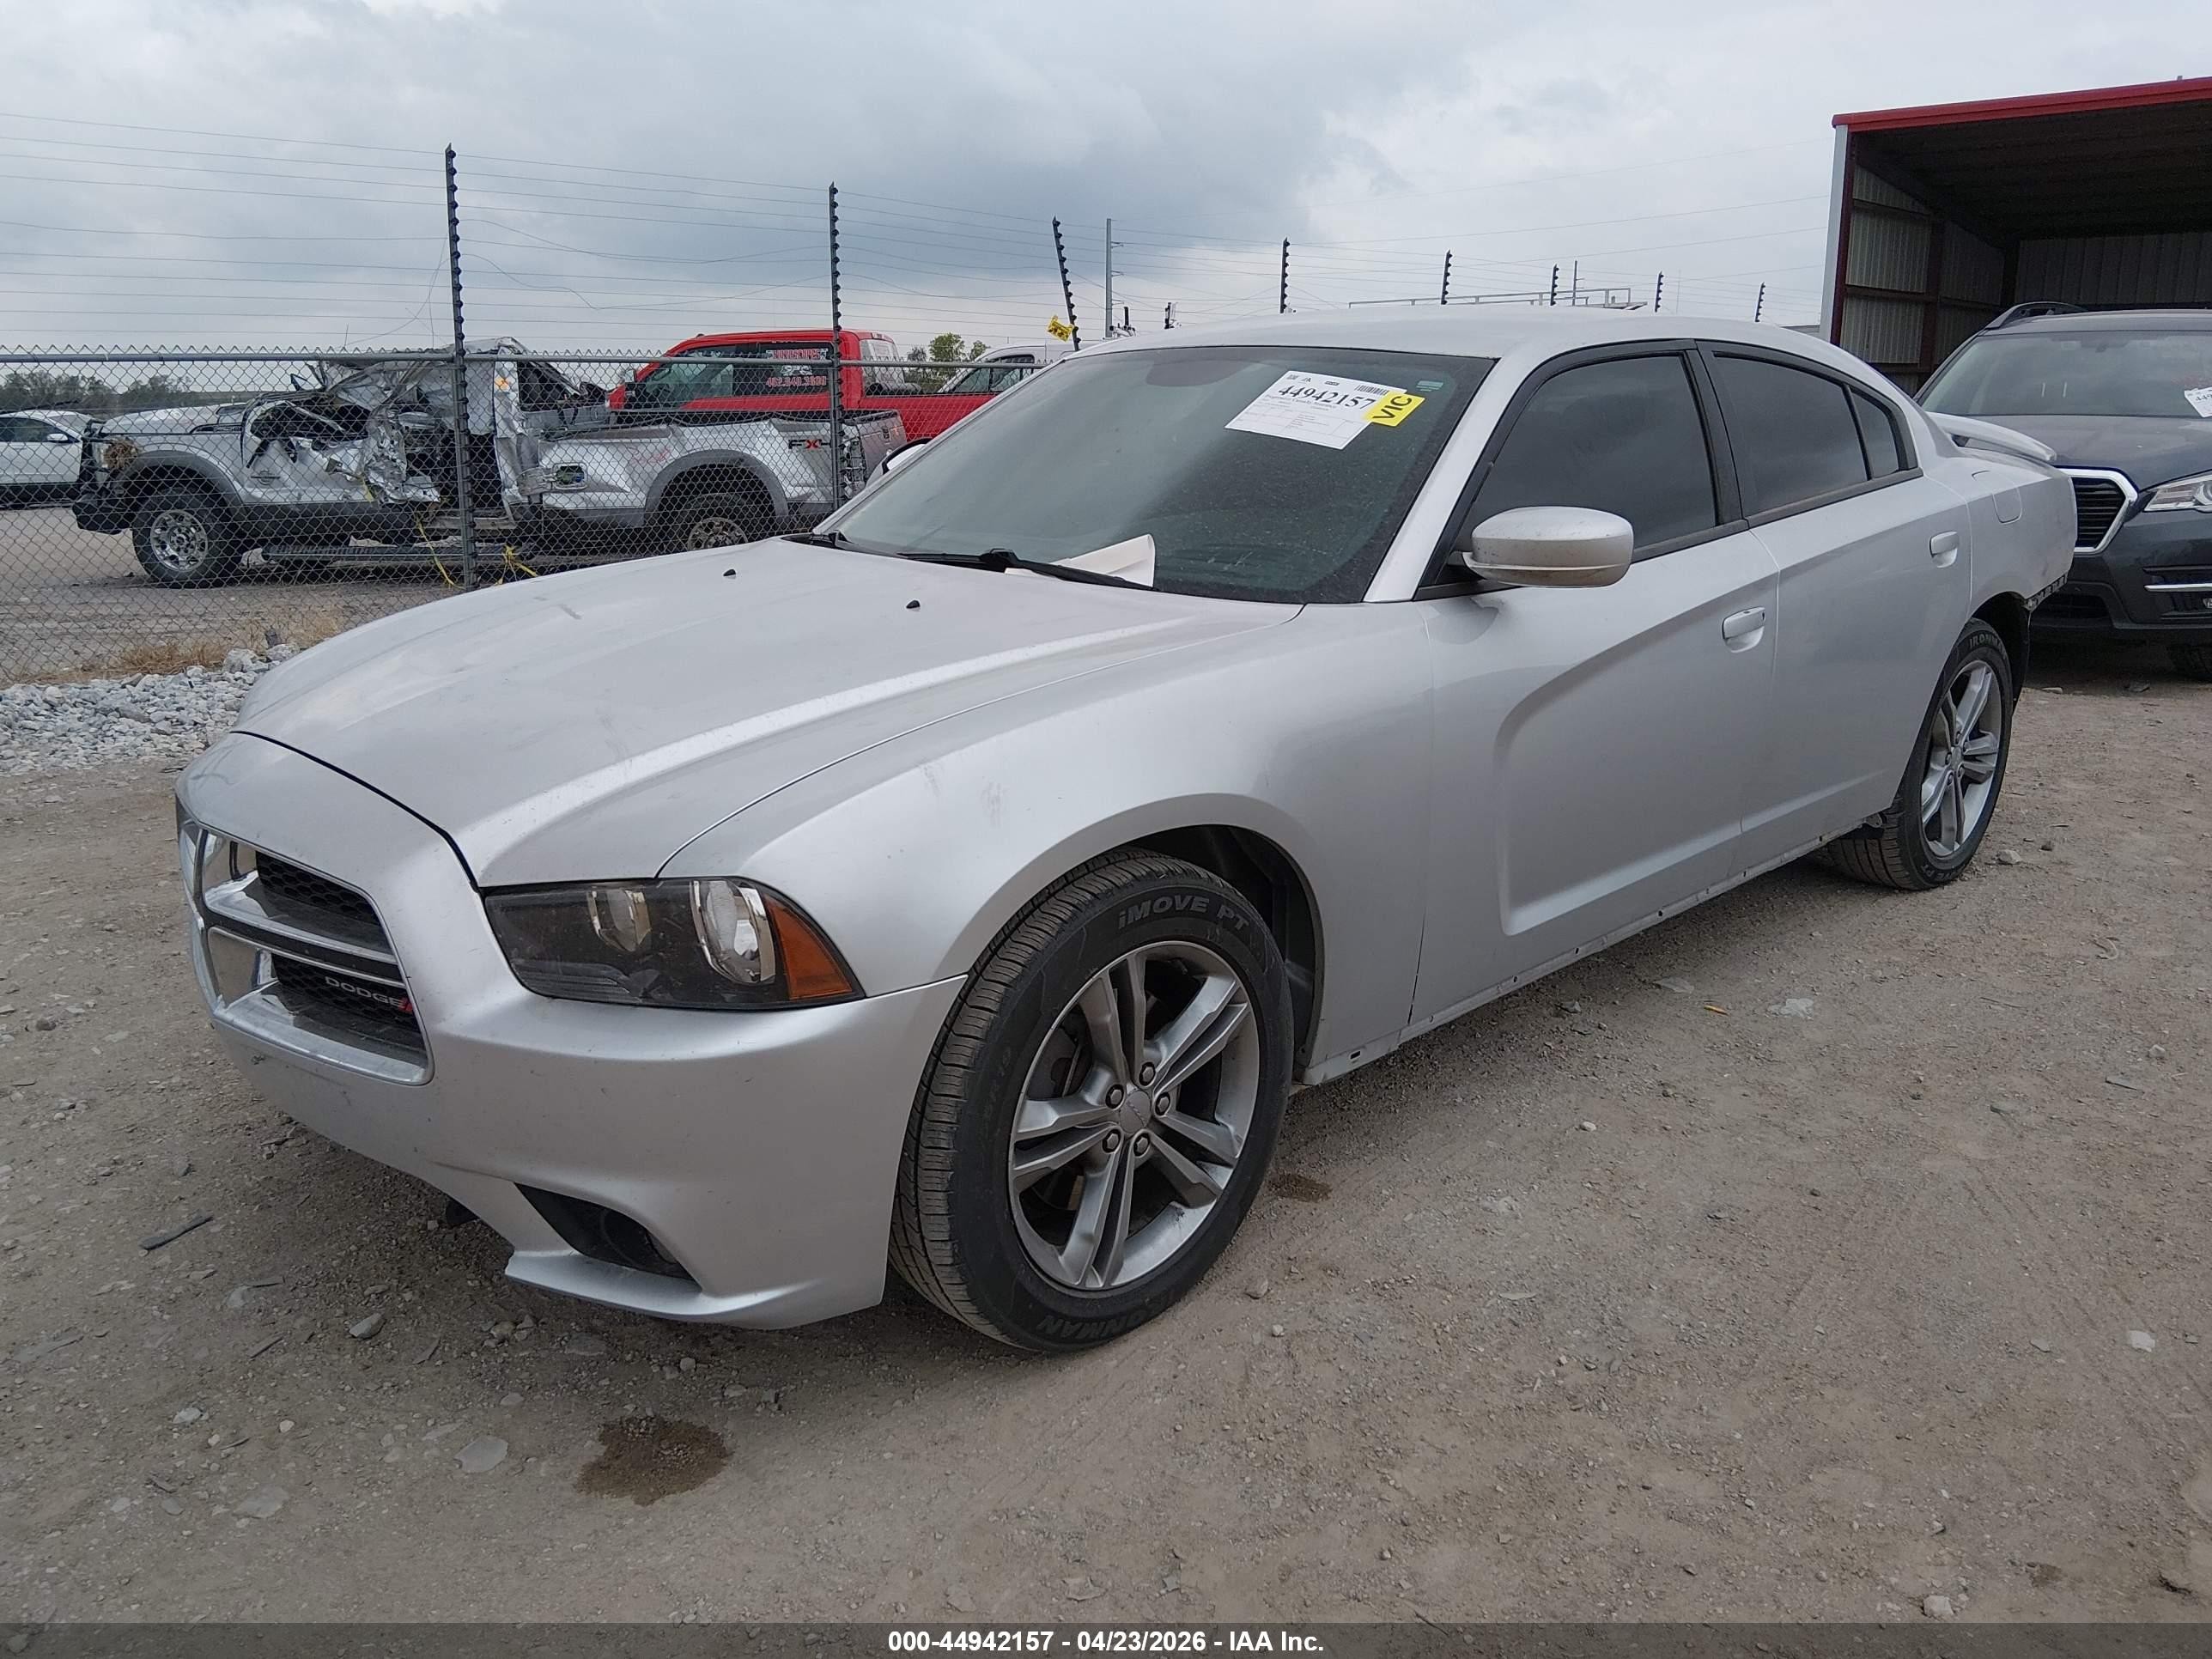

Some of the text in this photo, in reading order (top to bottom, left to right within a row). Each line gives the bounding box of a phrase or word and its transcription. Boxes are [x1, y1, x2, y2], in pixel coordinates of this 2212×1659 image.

[1279, 385, 1376, 410] 44942157
[1372, 396, 1413, 418] VIC
[1118, 895, 1250, 931] iMOVE PT
[325, 976, 403, 1009] DODGE
